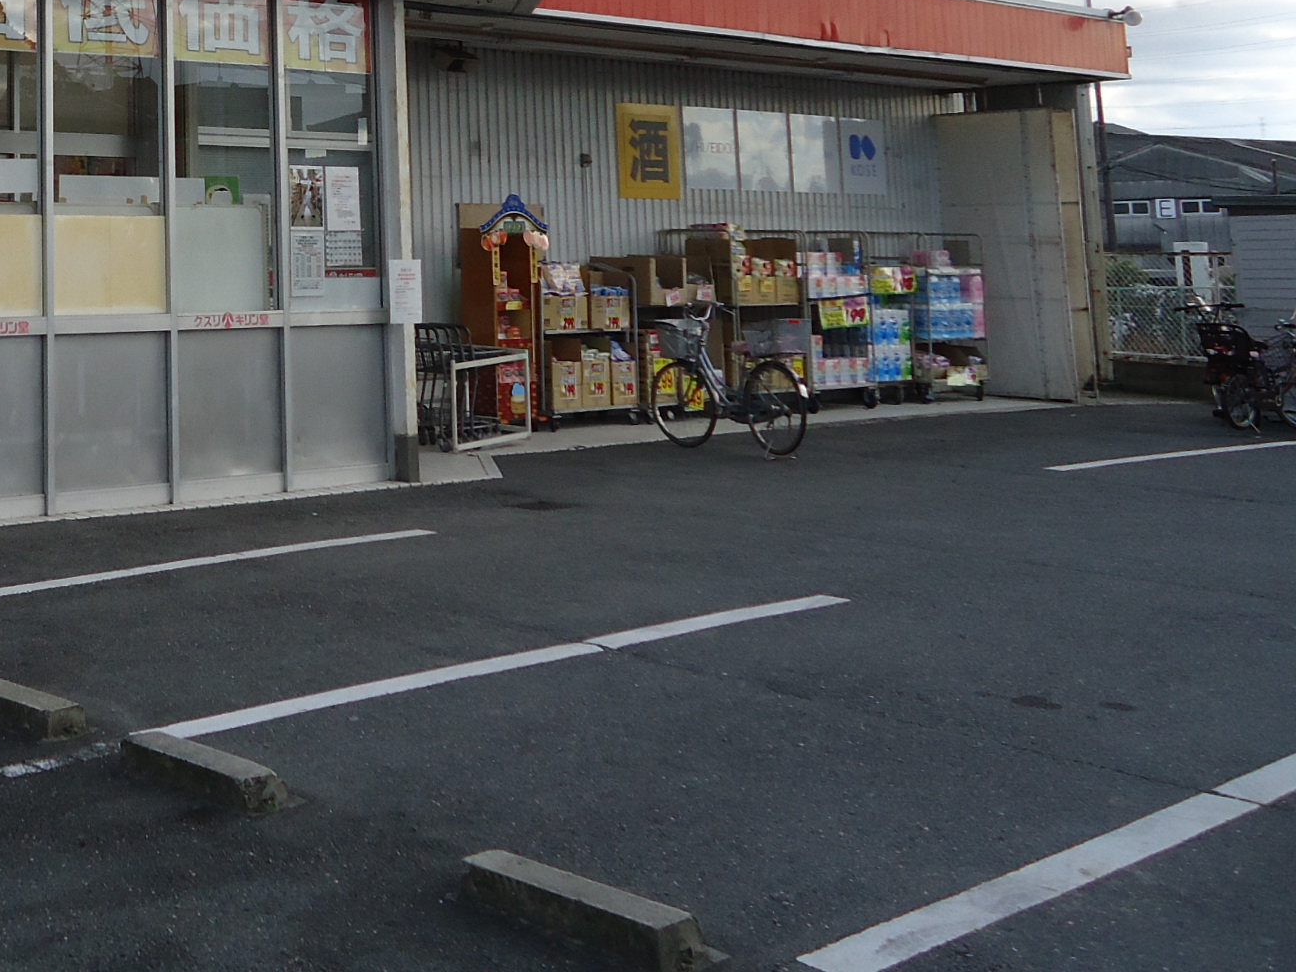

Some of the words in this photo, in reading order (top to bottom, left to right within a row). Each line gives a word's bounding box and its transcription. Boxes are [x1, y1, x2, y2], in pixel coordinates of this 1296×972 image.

[629, 118, 670, 184] 酒
[1158, 199, 1173, 217] E
[194, 314, 221, 326] クスリ
[235, 313, 270, 326] キリン堂
